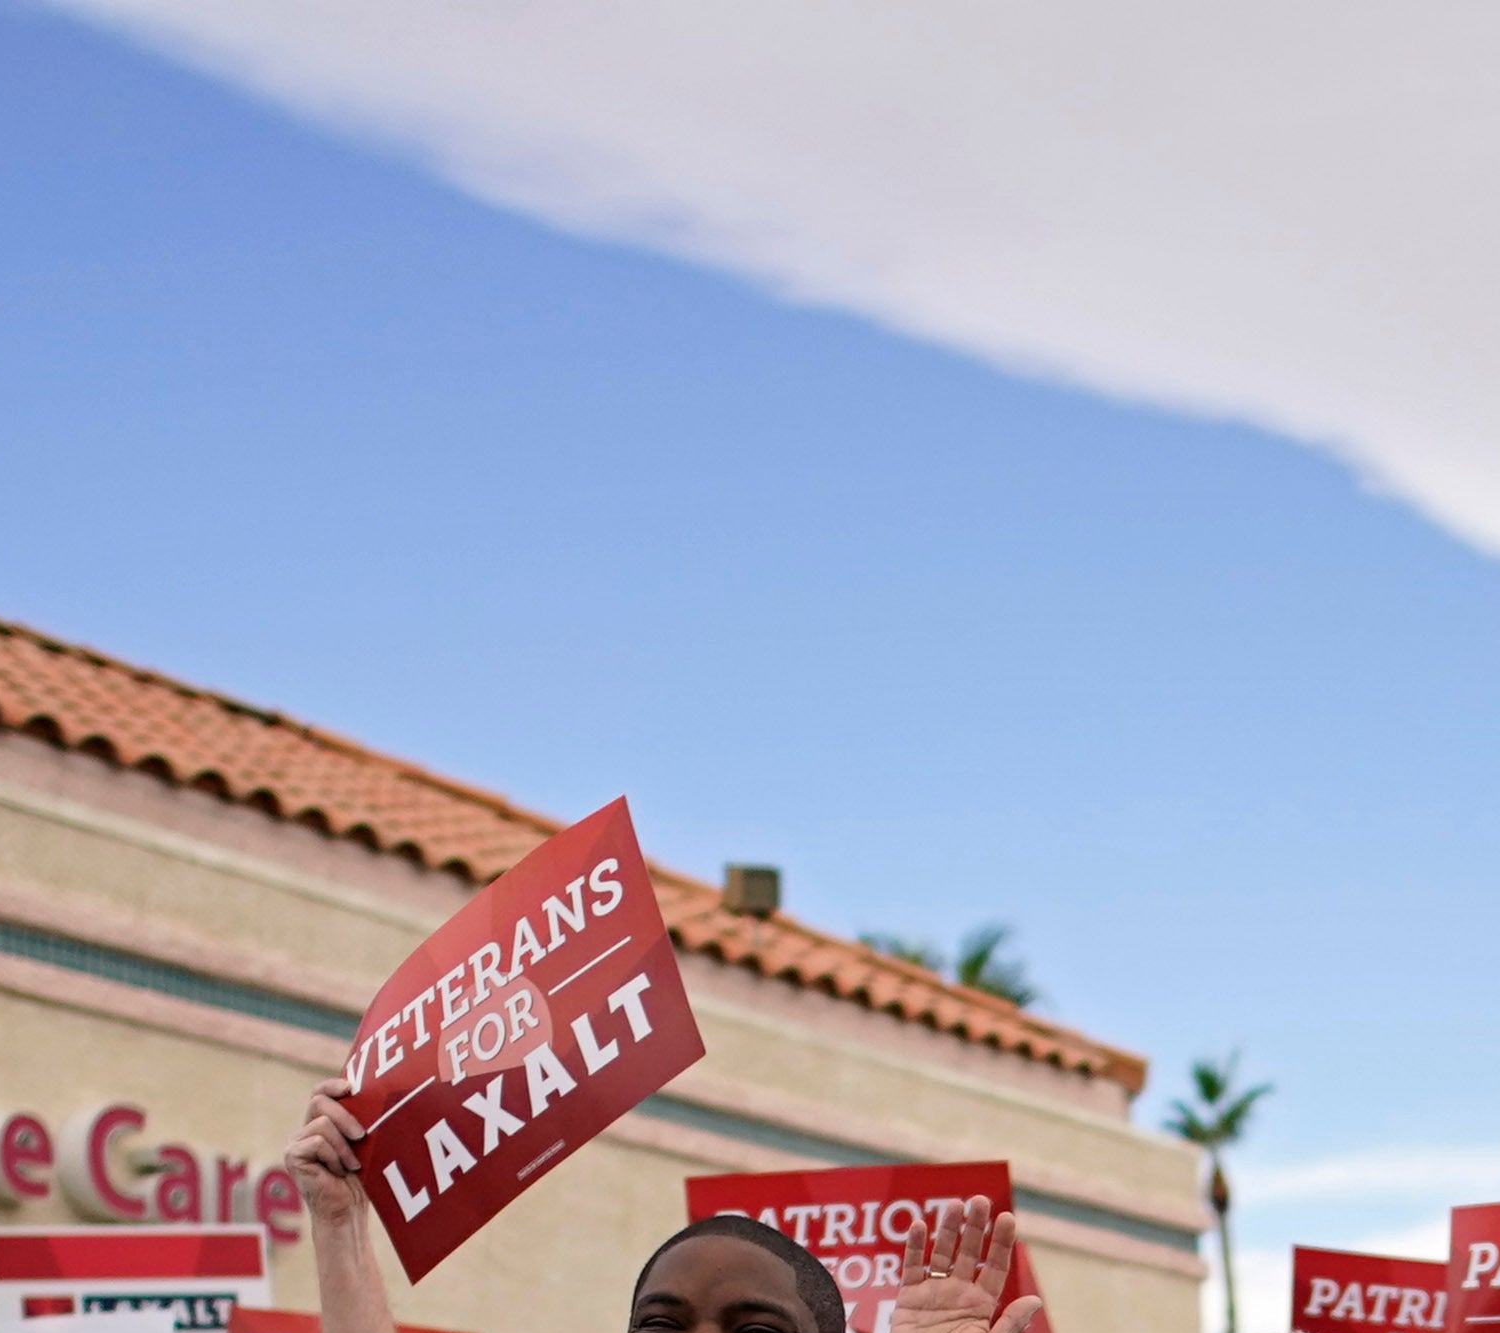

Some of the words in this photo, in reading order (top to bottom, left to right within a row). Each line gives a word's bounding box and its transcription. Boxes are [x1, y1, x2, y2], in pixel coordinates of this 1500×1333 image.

[344, 857, 625, 1097] VETERANS
[445, 988, 540, 1085] FOR
[87, 1106, 302, 1244] Care
[383, 972, 655, 1223] LAXALT
